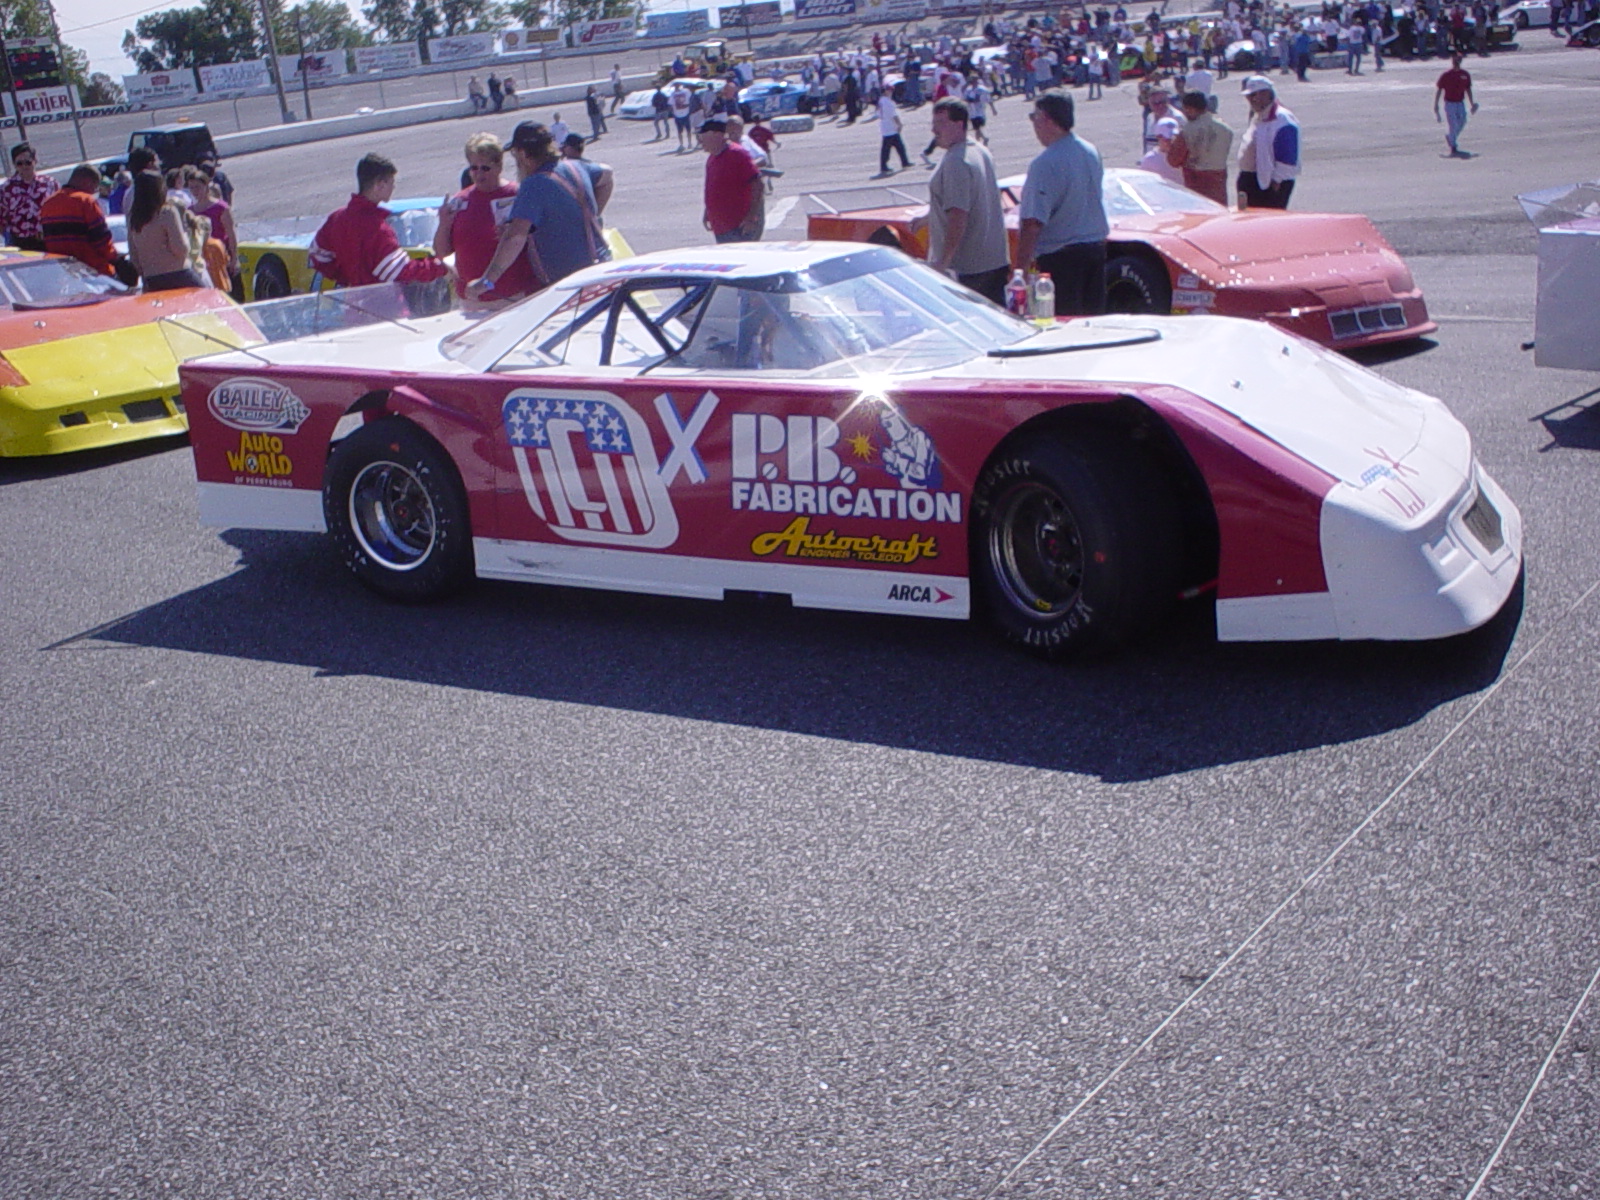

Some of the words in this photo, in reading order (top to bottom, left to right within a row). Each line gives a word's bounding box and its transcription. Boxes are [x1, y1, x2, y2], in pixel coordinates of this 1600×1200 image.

[797, 3, 856, 25] LIGHT
[18, 92, 70, 114] MEIJER
[0, 113, 53, 129] OEDO
[219, 387, 284, 410] BAILEY
[223, 409, 281, 423] RACING
[240, 430, 284, 454] Auto
[732, 413, 857, 485] P.B.
[226, 451, 293, 478] WORLD
[731, 481, 962, 523] FABRICATION
[751, 516, 939, 564] Autocraft
[857, 551, 903, 563] TOLEDO
[888, 584, 932, 603] ARCA
